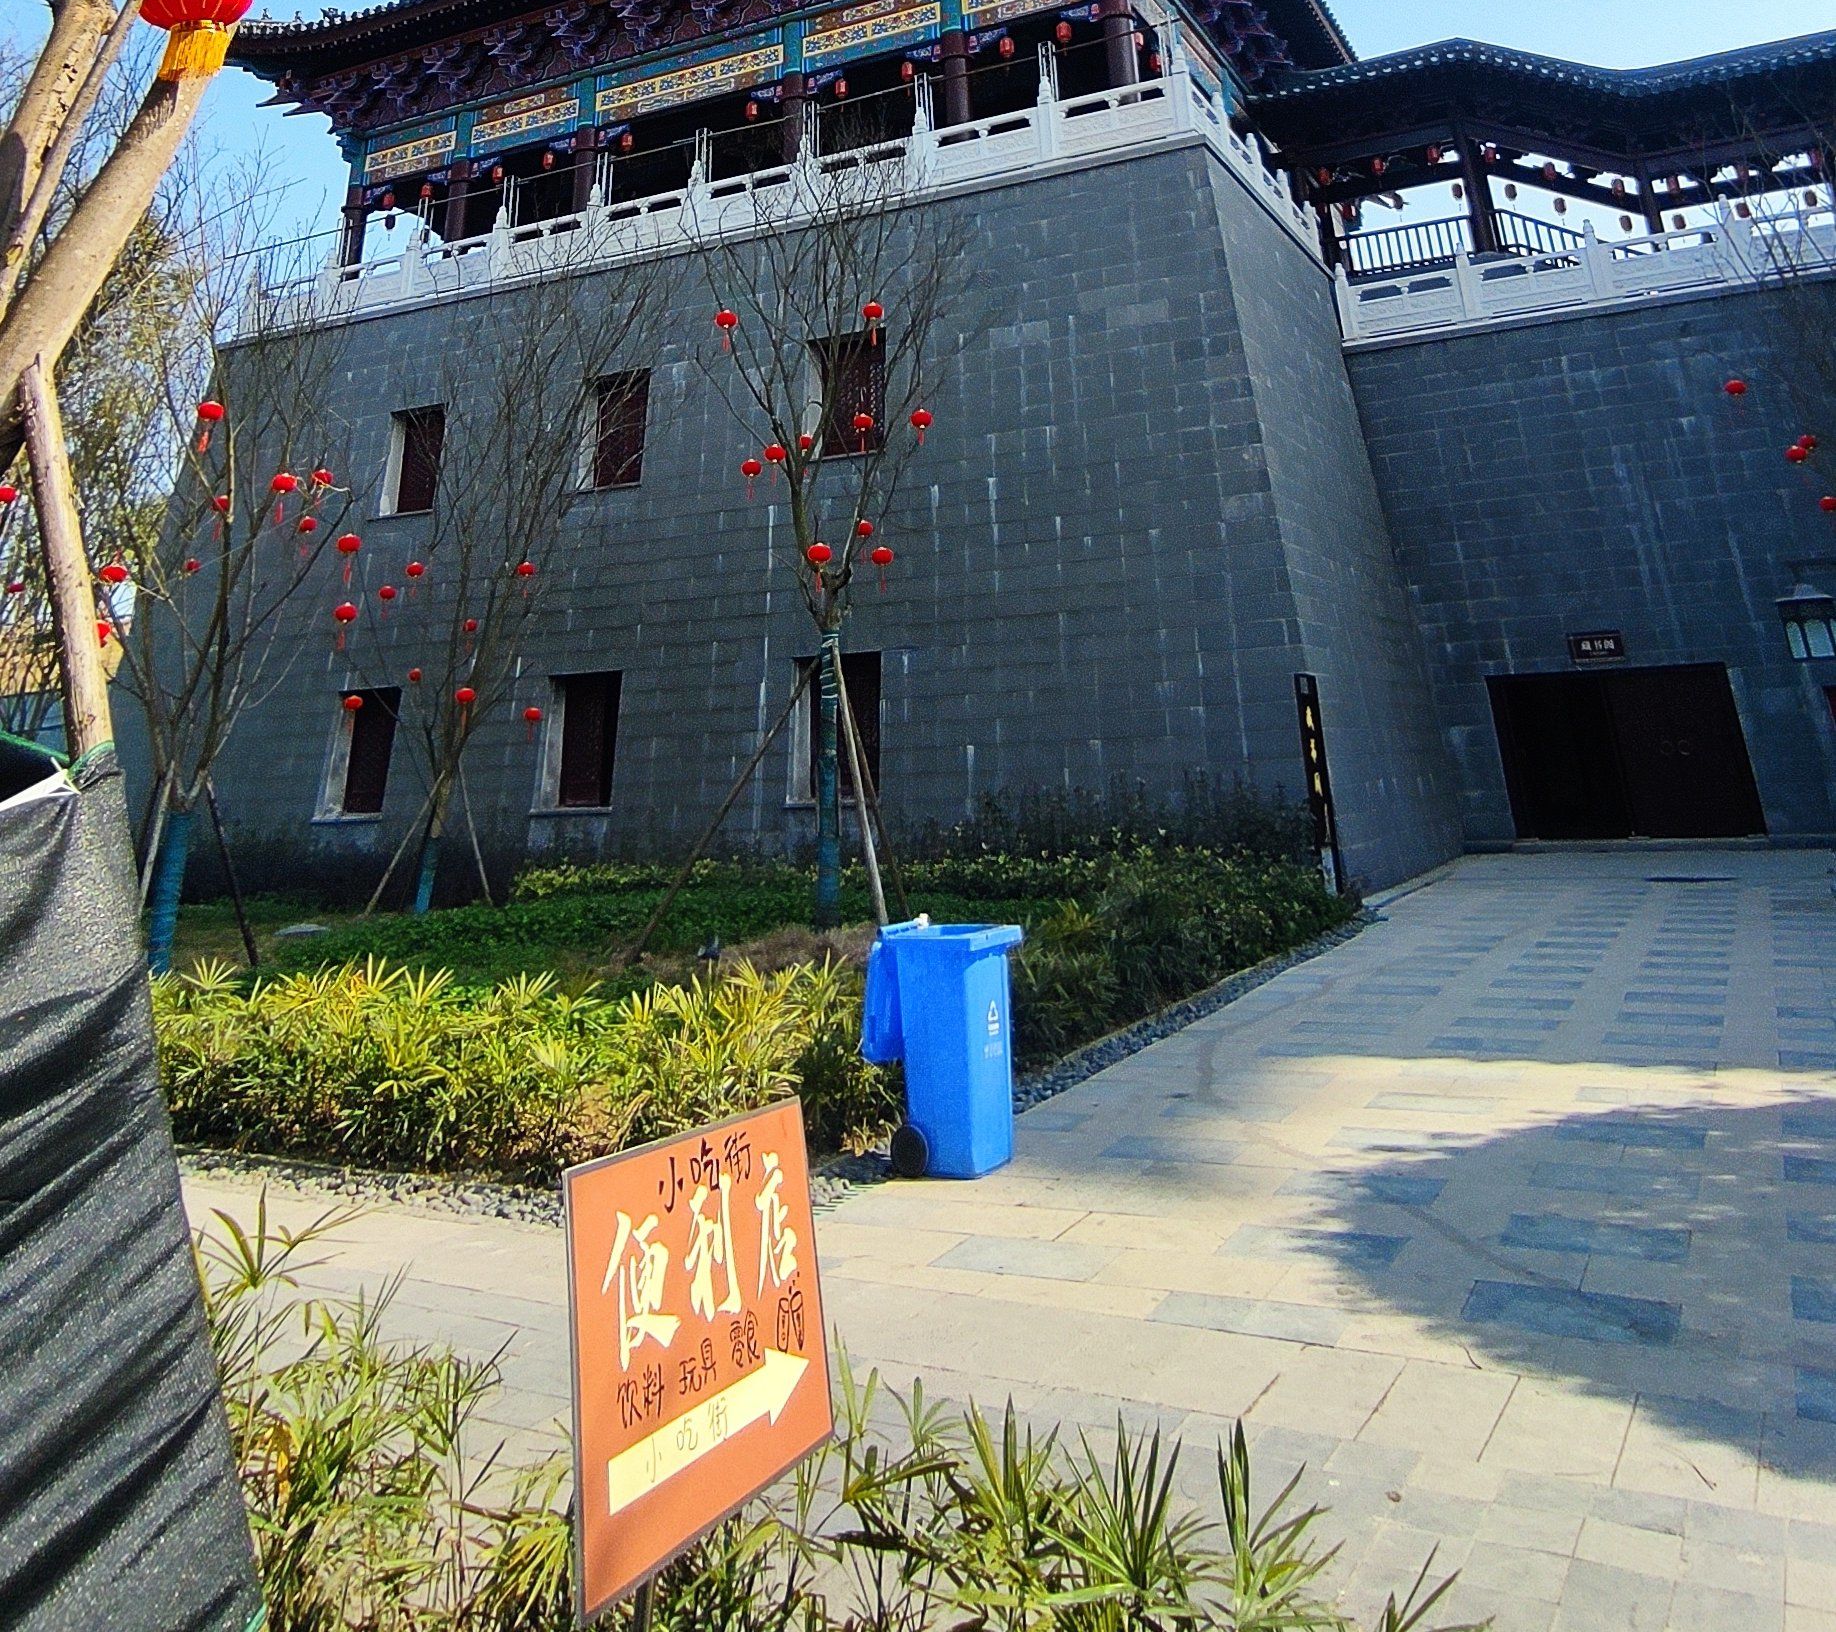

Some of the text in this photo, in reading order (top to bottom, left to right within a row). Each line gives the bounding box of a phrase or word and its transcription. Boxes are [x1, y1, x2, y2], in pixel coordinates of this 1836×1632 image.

[658, 1131, 752, 1214] 小吃街
[601, 1152, 799, 1373] 便利店
[616, 1363, 665, 1430] 饮料
[678, 1337, 717, 1395] 玩具
[646, 1397, 729, 1483] 小吃街
